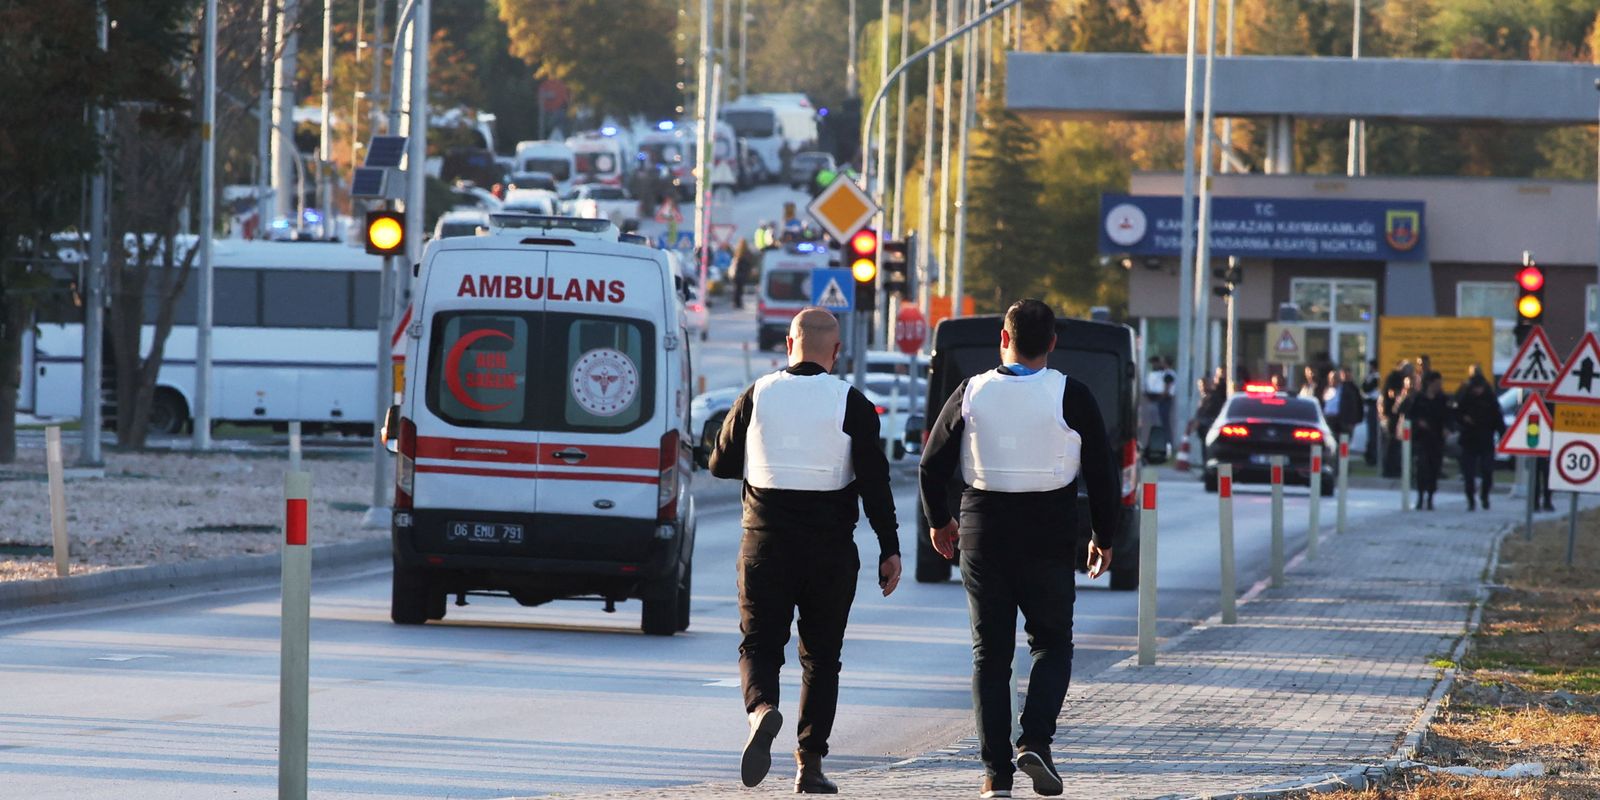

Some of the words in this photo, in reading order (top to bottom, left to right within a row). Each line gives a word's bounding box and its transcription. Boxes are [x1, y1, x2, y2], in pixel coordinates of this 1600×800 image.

[457, 274, 625, 303] AMBULANS
[1566, 453, 1592, 472] 30
[454, 523, 468, 537] 06
[502, 526, 521, 539] 791
